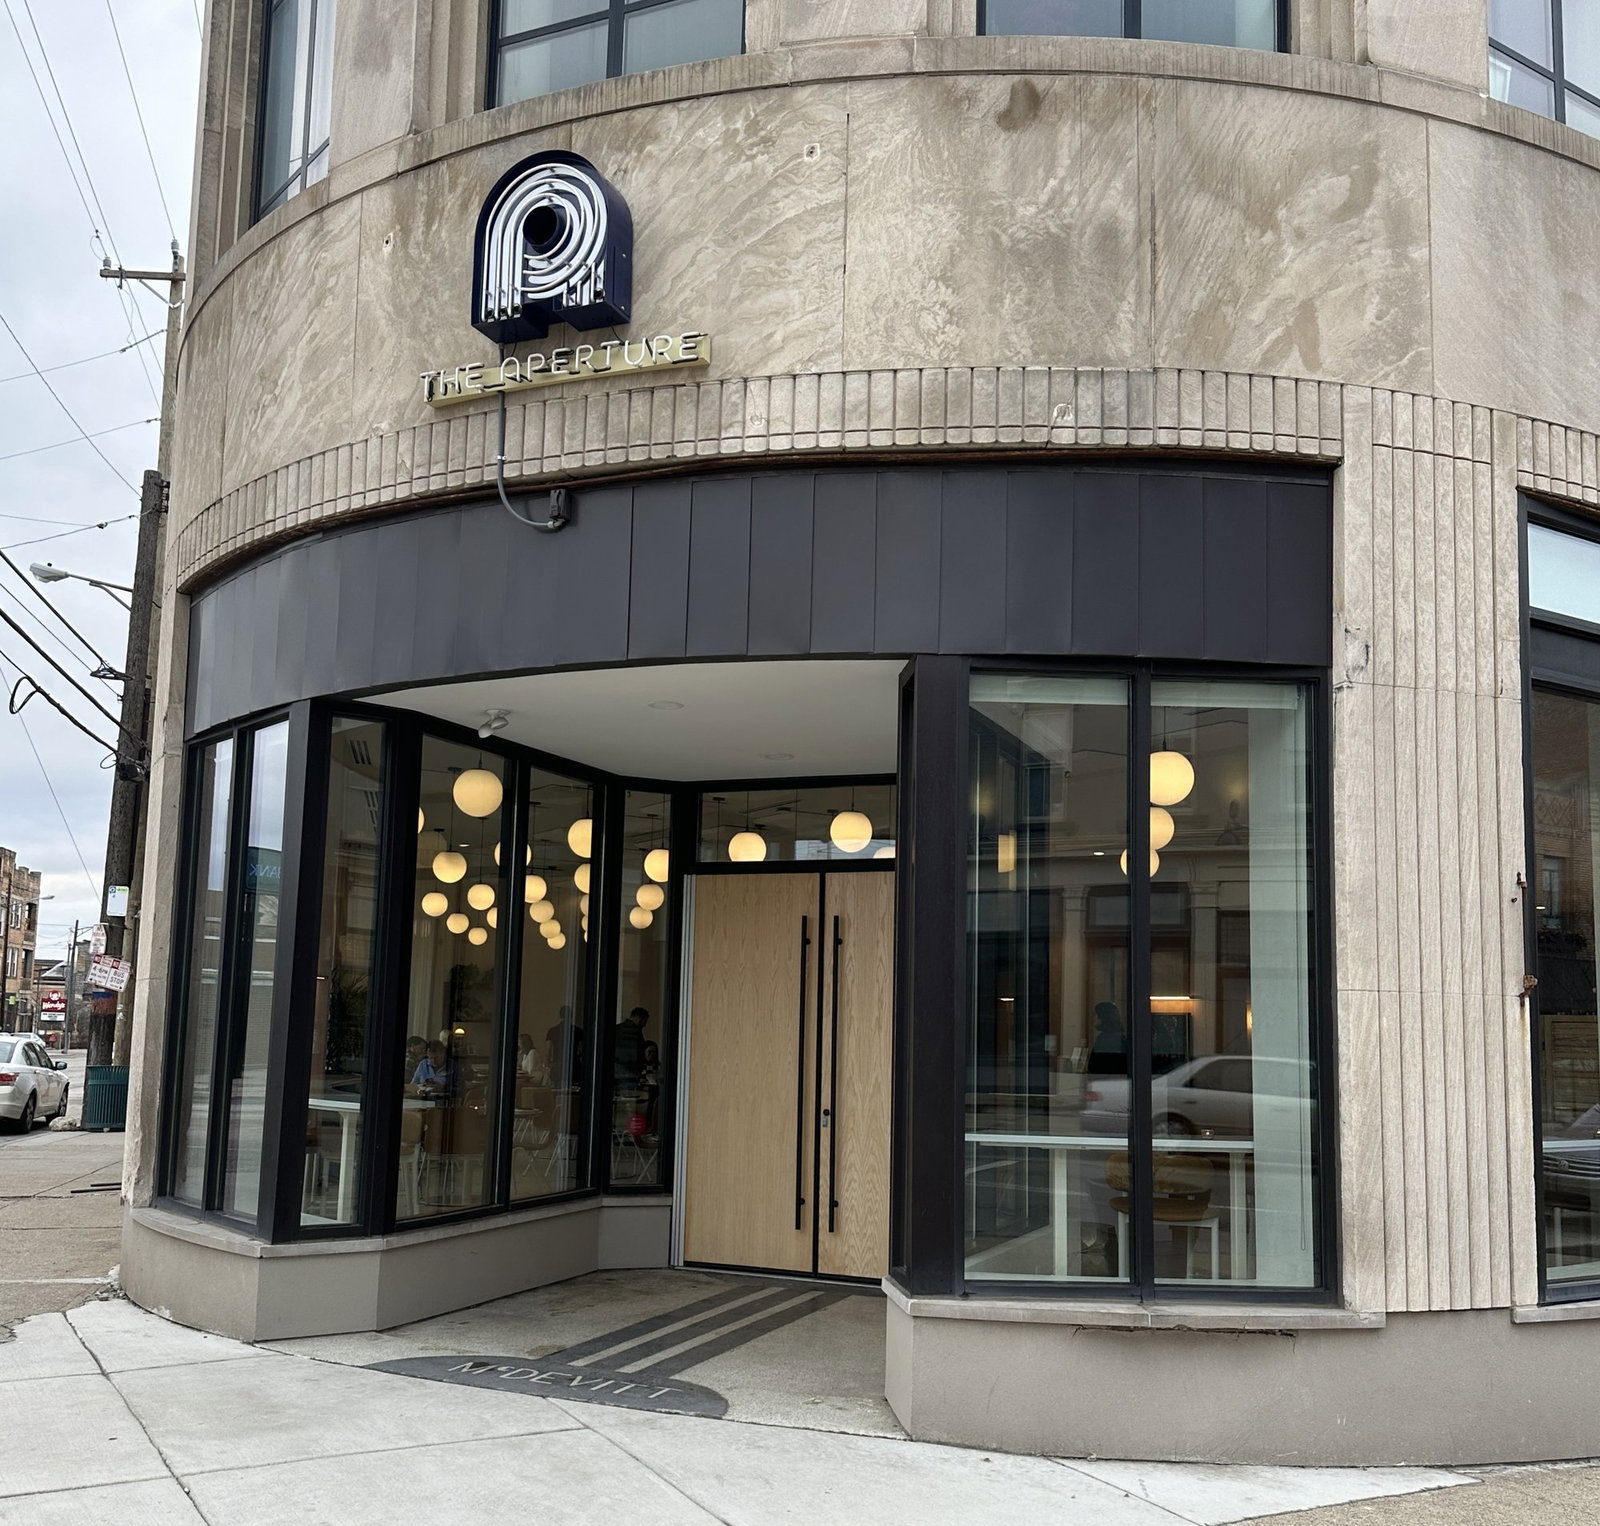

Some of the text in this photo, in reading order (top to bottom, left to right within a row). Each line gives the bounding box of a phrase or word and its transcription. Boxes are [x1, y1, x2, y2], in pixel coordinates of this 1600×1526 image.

[420, 332, 703, 399] THE APERTURE
[110, 976, 125, 985] STOP
